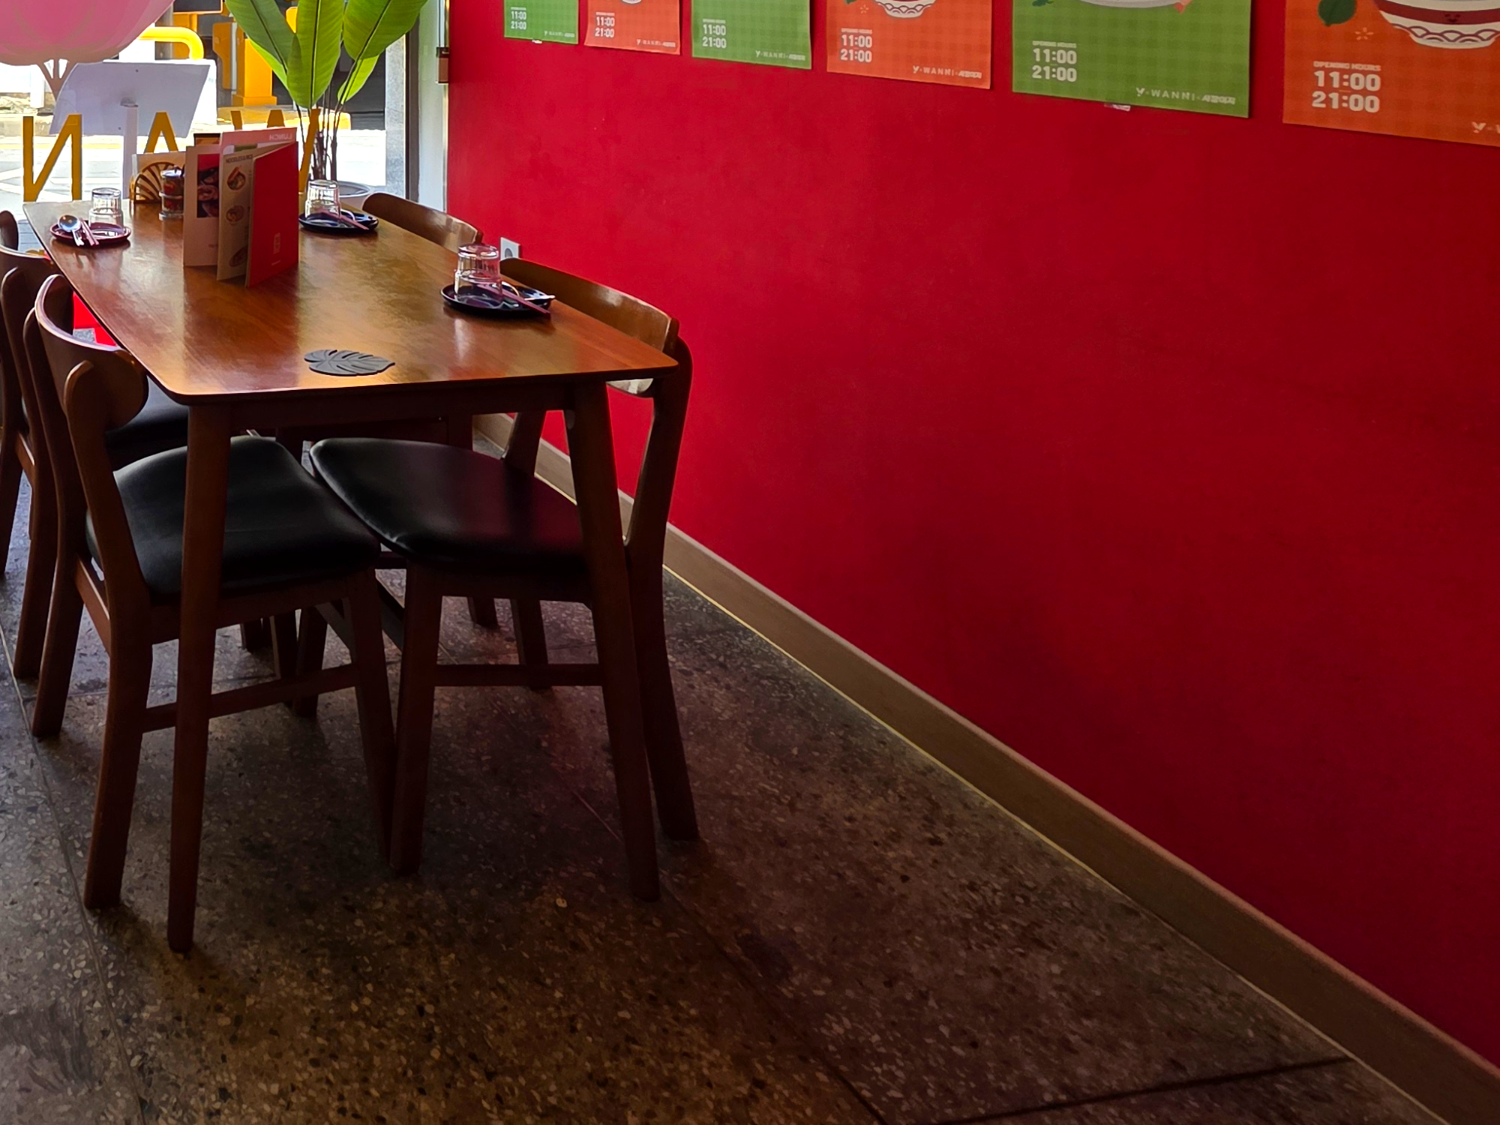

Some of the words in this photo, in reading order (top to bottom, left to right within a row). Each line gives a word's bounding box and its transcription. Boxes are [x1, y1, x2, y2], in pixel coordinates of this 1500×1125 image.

[510, 10, 527, 20] 11:00
[510, 21, 527, 30] 21:00
[596, 16, 616, 27] 11:00
[595, 28, 615, 38] 21:00
[703, 24, 726, 36] 11:00
[702, 36, 727, 48] 21:00
[841, 34, 873, 48] 11:00
[840, 48, 873, 63] 21:00
[1033, 48, 1077, 64] 11:00
[923, 66, 954, 76] WANNI
[1313, 60, 1350, 70] OPENING
[1351, 63, 1382, 72] HOURS
[1032, 65, 1078, 82] 21:00
[1314, 70, 1381, 92] 11:00
[1151, 89, 1195, 101] WANNI
[1311, 91, 1381, 113] 21:00
